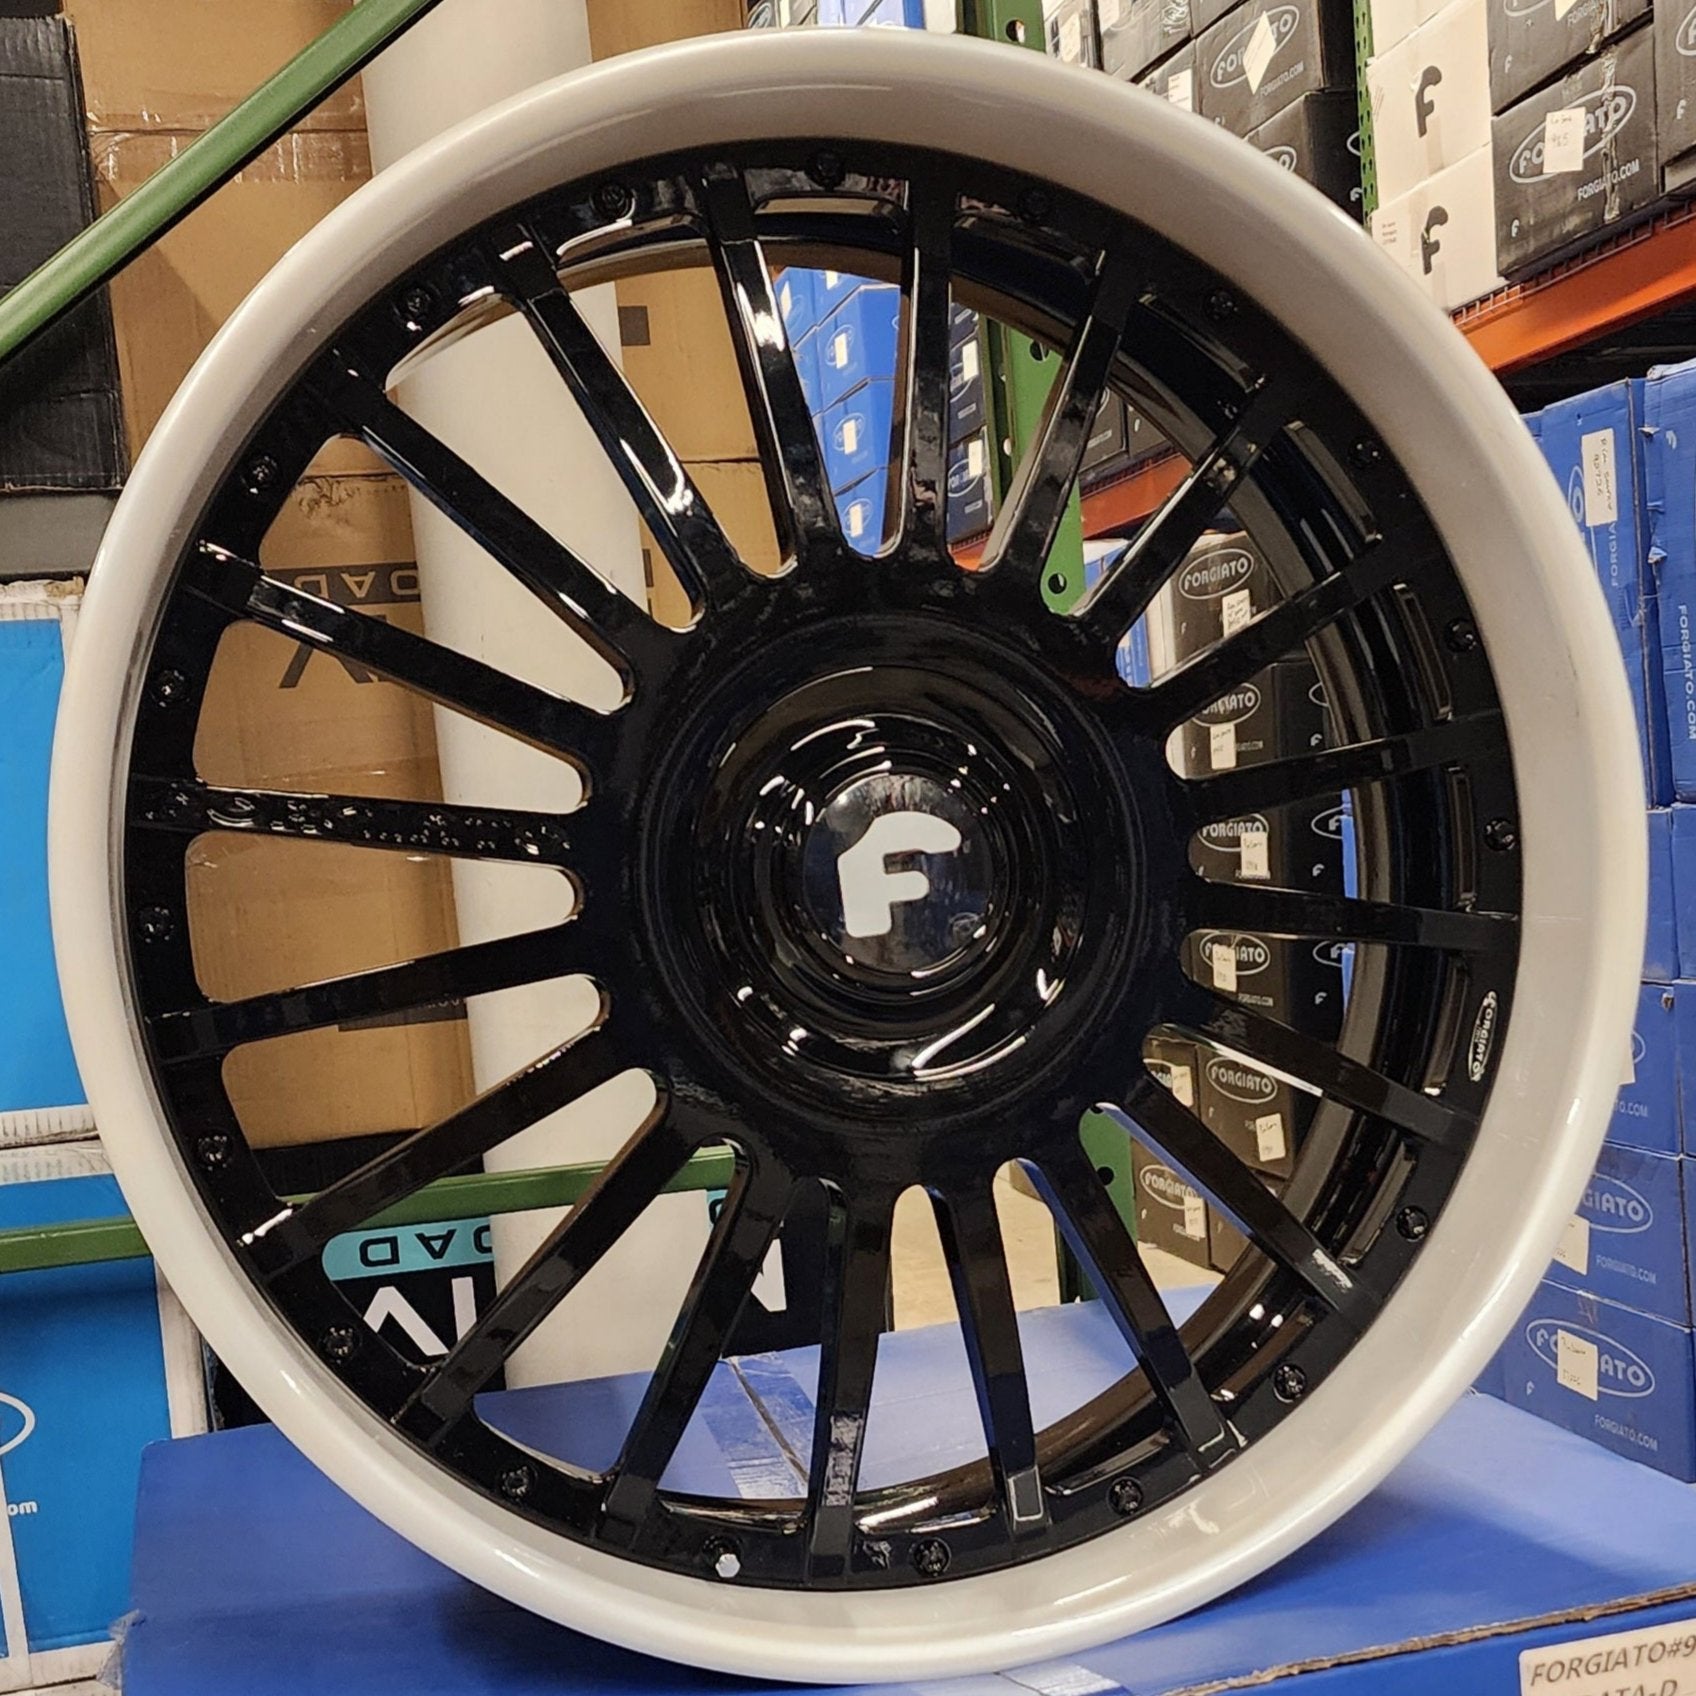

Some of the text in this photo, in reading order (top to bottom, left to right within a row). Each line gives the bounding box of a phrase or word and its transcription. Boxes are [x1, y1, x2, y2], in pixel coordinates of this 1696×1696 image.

[1217, 13, 1292, 81] FORTO
[1519, 95, 1627, 174] FOATO
[1184, 557, 1249, 591] FORGIATO
[1607, 522, 1619, 587] FORGIA
[1678, 604, 1696, 740] FORGIATO.COM
[837, 811, 962, 938] F
[1205, 942, 1266, 963] FIATO
[1471, 991, 1497, 1076] FORGIATO
[1211, 1066, 1272, 1094] FORGIATO
[1583, 1190, 1644, 1222] GIATO
[1536, 1328, 1646, 1387] FOATO
[1594, 1414, 1658, 1452] FORGIATO.COM
